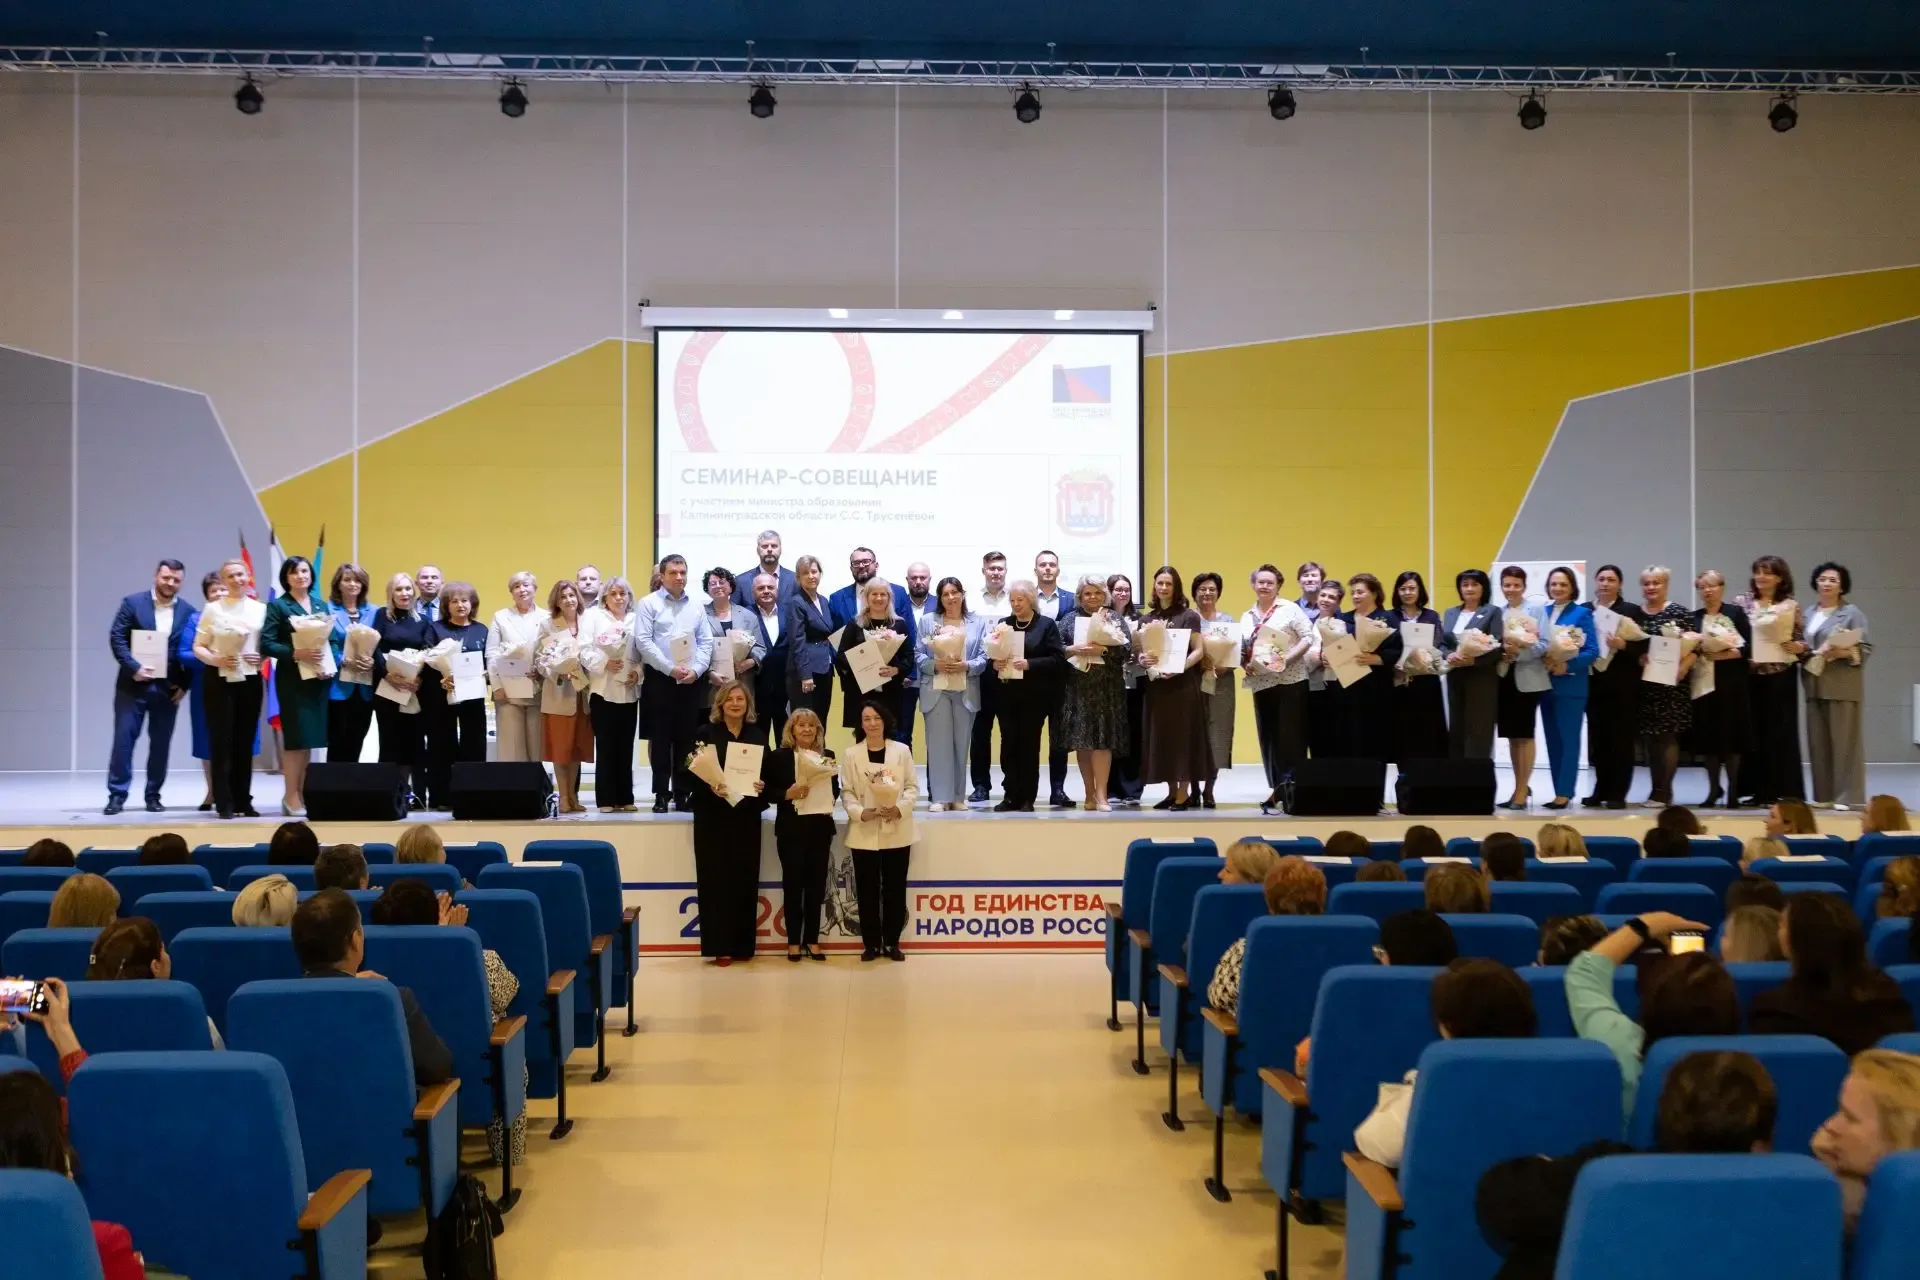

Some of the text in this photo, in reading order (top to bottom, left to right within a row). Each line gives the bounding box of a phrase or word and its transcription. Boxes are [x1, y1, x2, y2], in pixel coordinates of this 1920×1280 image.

[680, 468, 938, 488] СЕМИНАР-СОВЕЩАНИЕ
[748, 498, 804, 508] министра
[807, 496, 882, 507] образования
[788, 509, 837, 520] области
[916, 894, 1106, 914] ГОД ЕДИНСТВА
[916, 918, 1106, 938] НАРОДОВ РОСС
